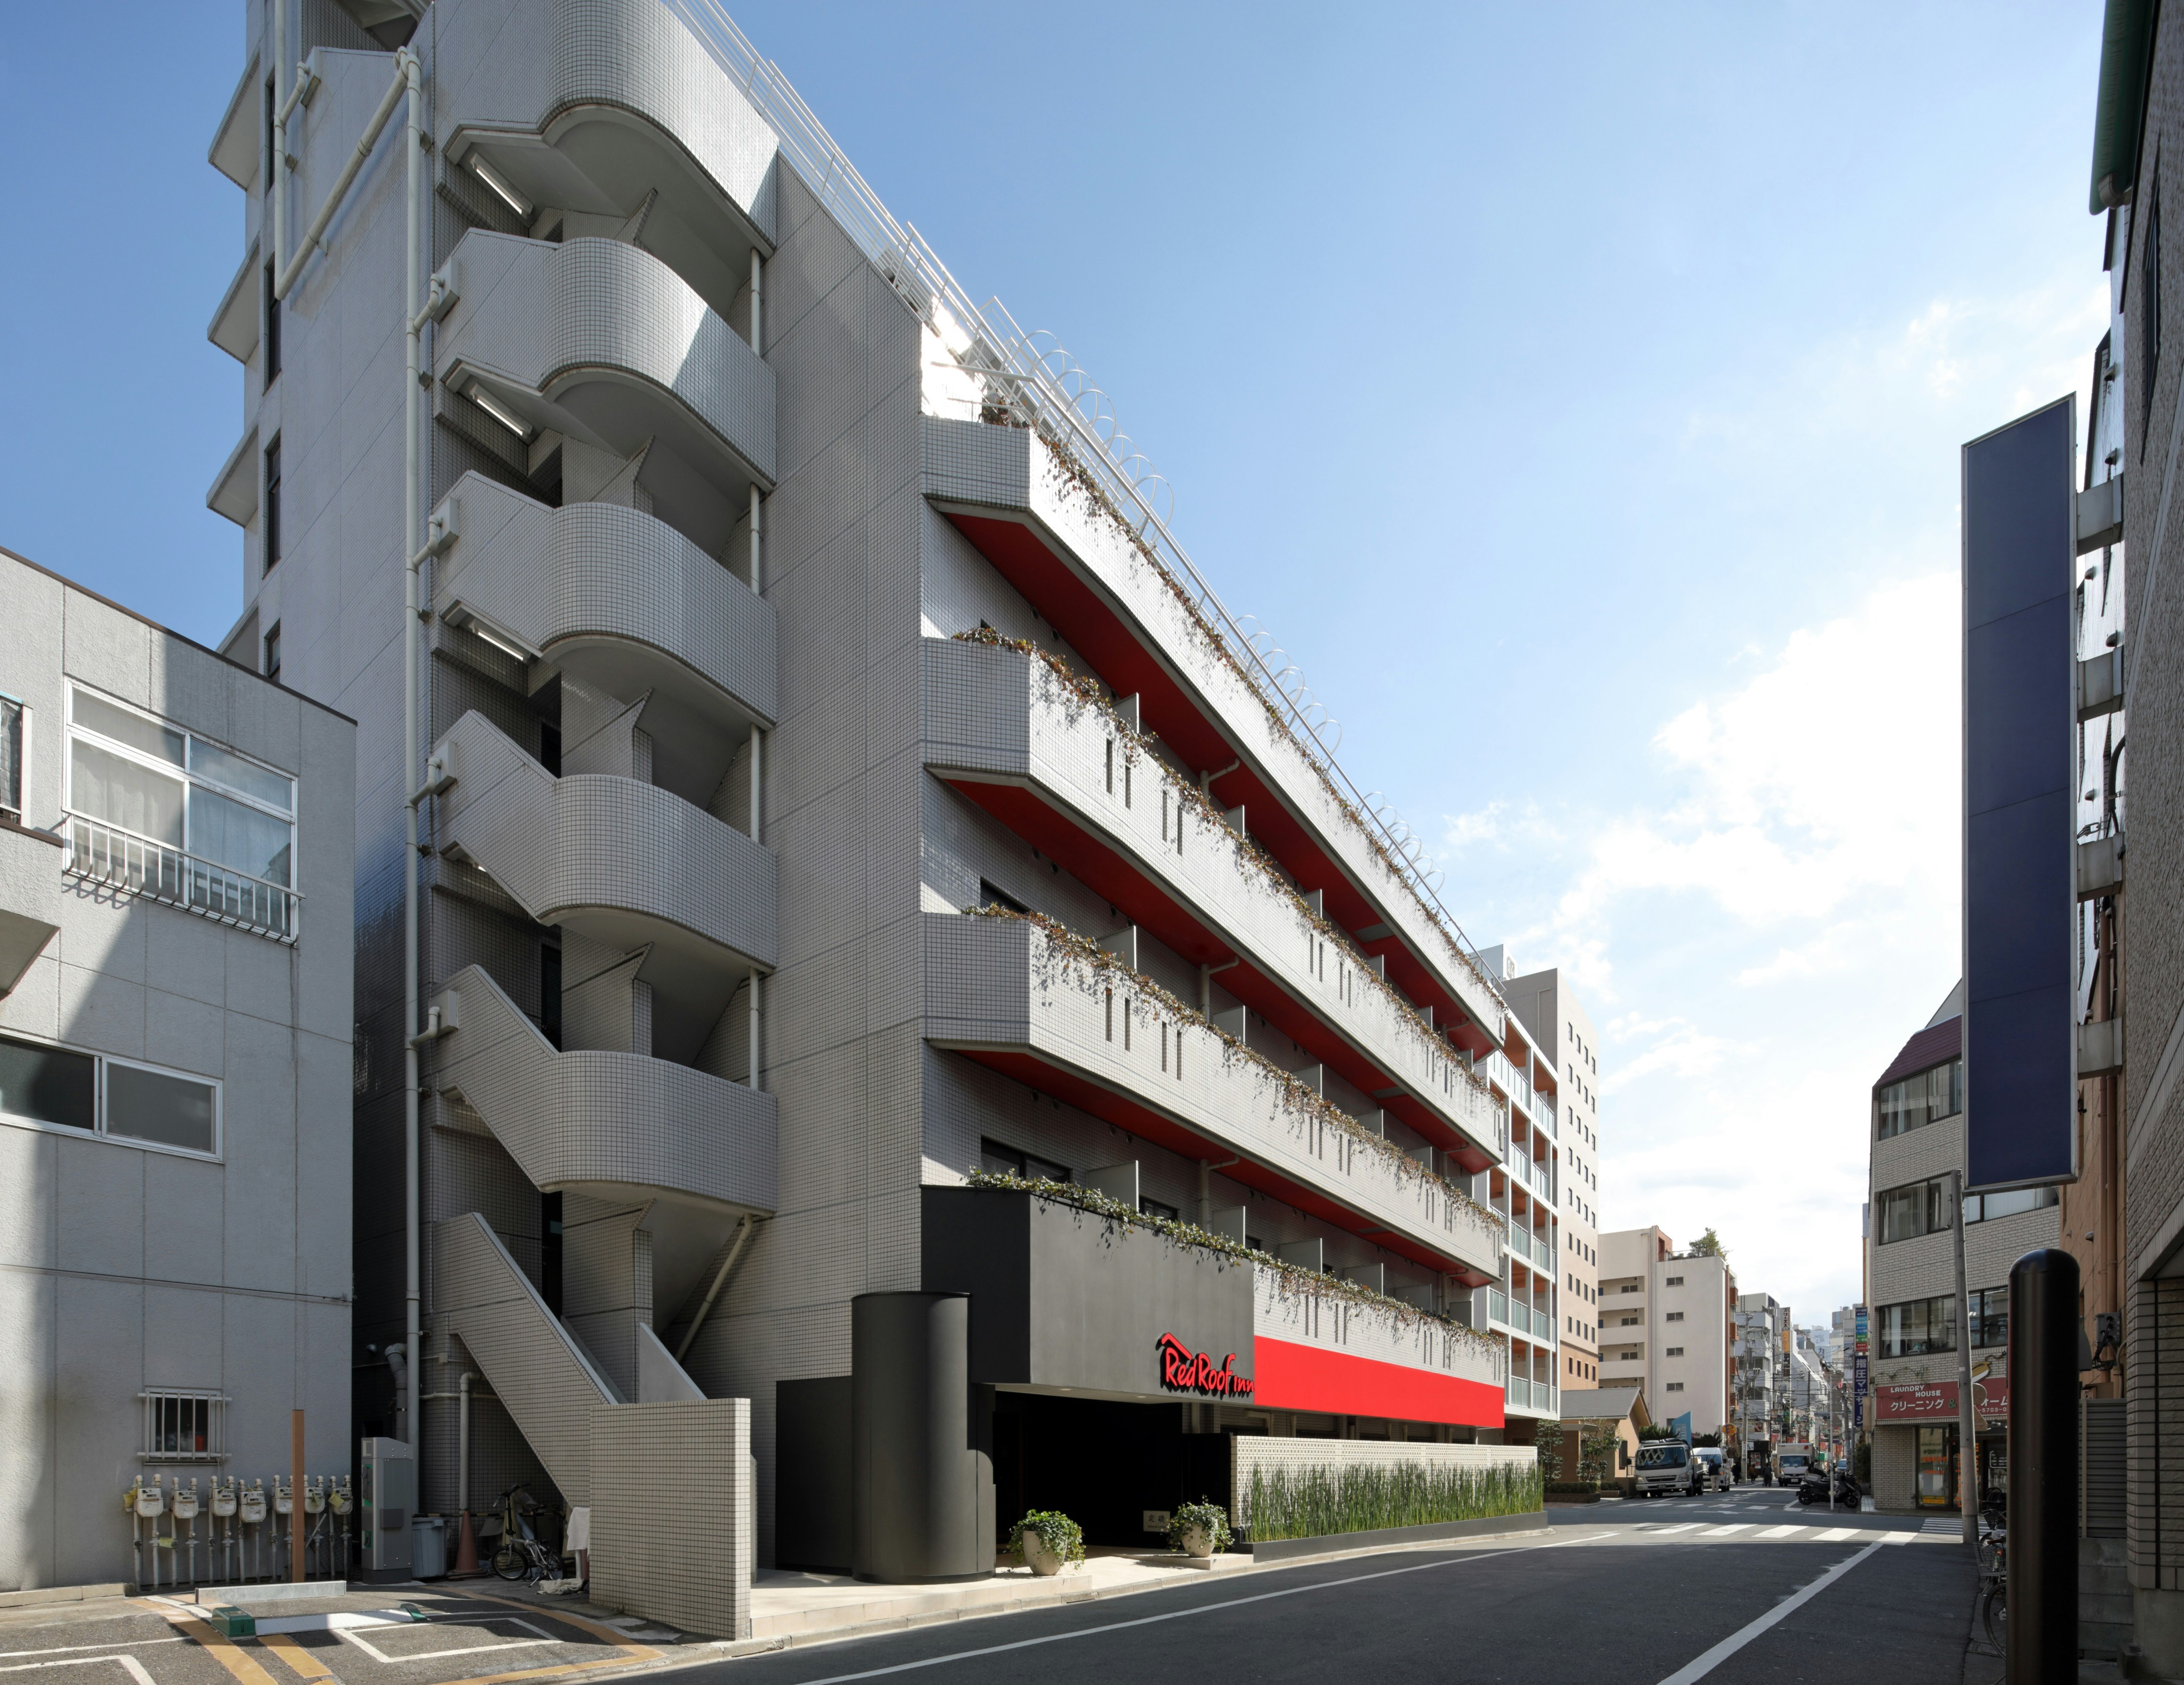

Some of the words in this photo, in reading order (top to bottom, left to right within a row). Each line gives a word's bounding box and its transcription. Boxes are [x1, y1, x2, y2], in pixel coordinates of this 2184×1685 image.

[1165, 1347, 1197, 1387] Red
[1198, 1352, 1236, 1395] Roof
[1891, 1385, 1925, 1393] LAUNDRY
[1890, 1399, 1944, 1411] クリーニング
[1948, 1399, 1957, 1408] &
